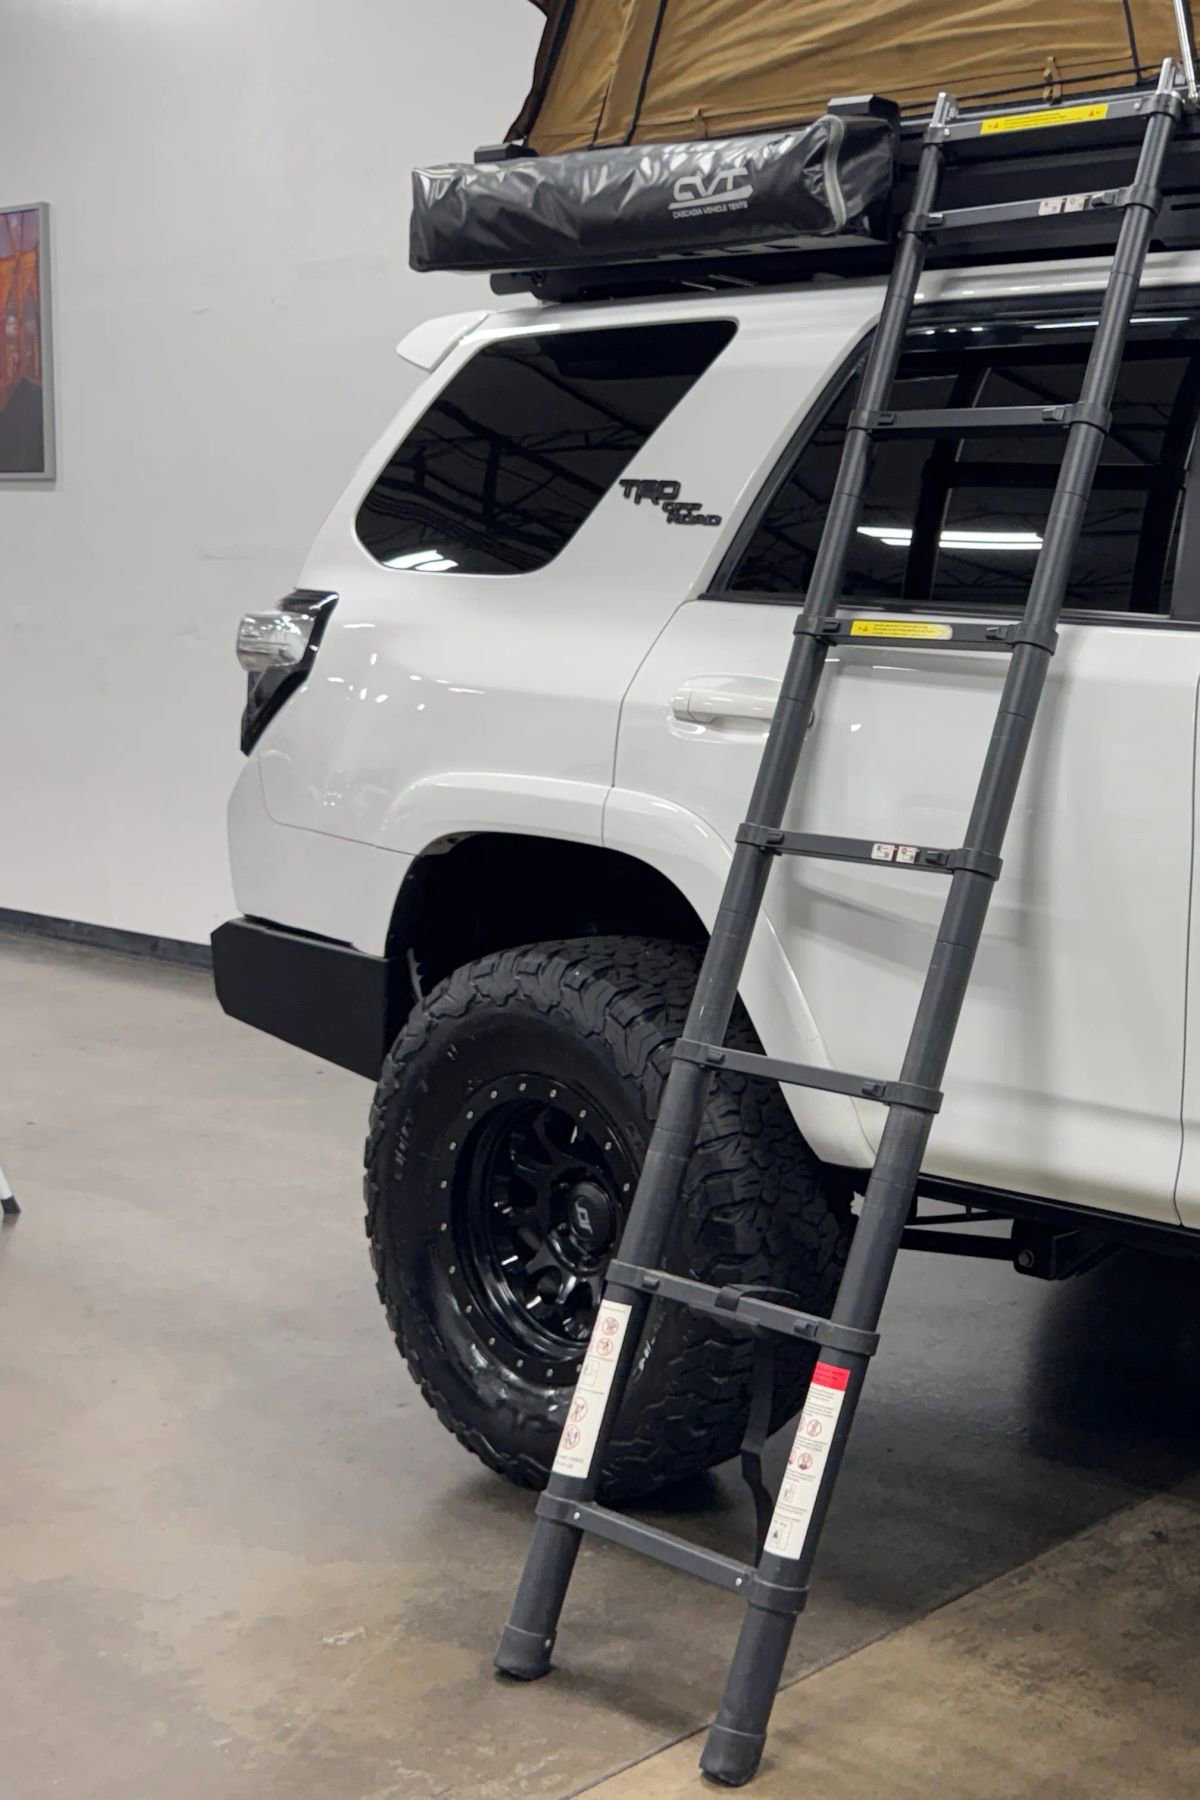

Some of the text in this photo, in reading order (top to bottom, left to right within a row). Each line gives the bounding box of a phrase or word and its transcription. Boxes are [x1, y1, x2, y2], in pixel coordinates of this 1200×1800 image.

[673, 166, 749, 201] CVT
[703, 203, 728, 214] VEHICLE
[728, 200, 748, 210] TENTS
[619, 479, 681, 505] TRD
[662, 501, 703, 515] OFF
[666, 513, 722, 527] ROAD
